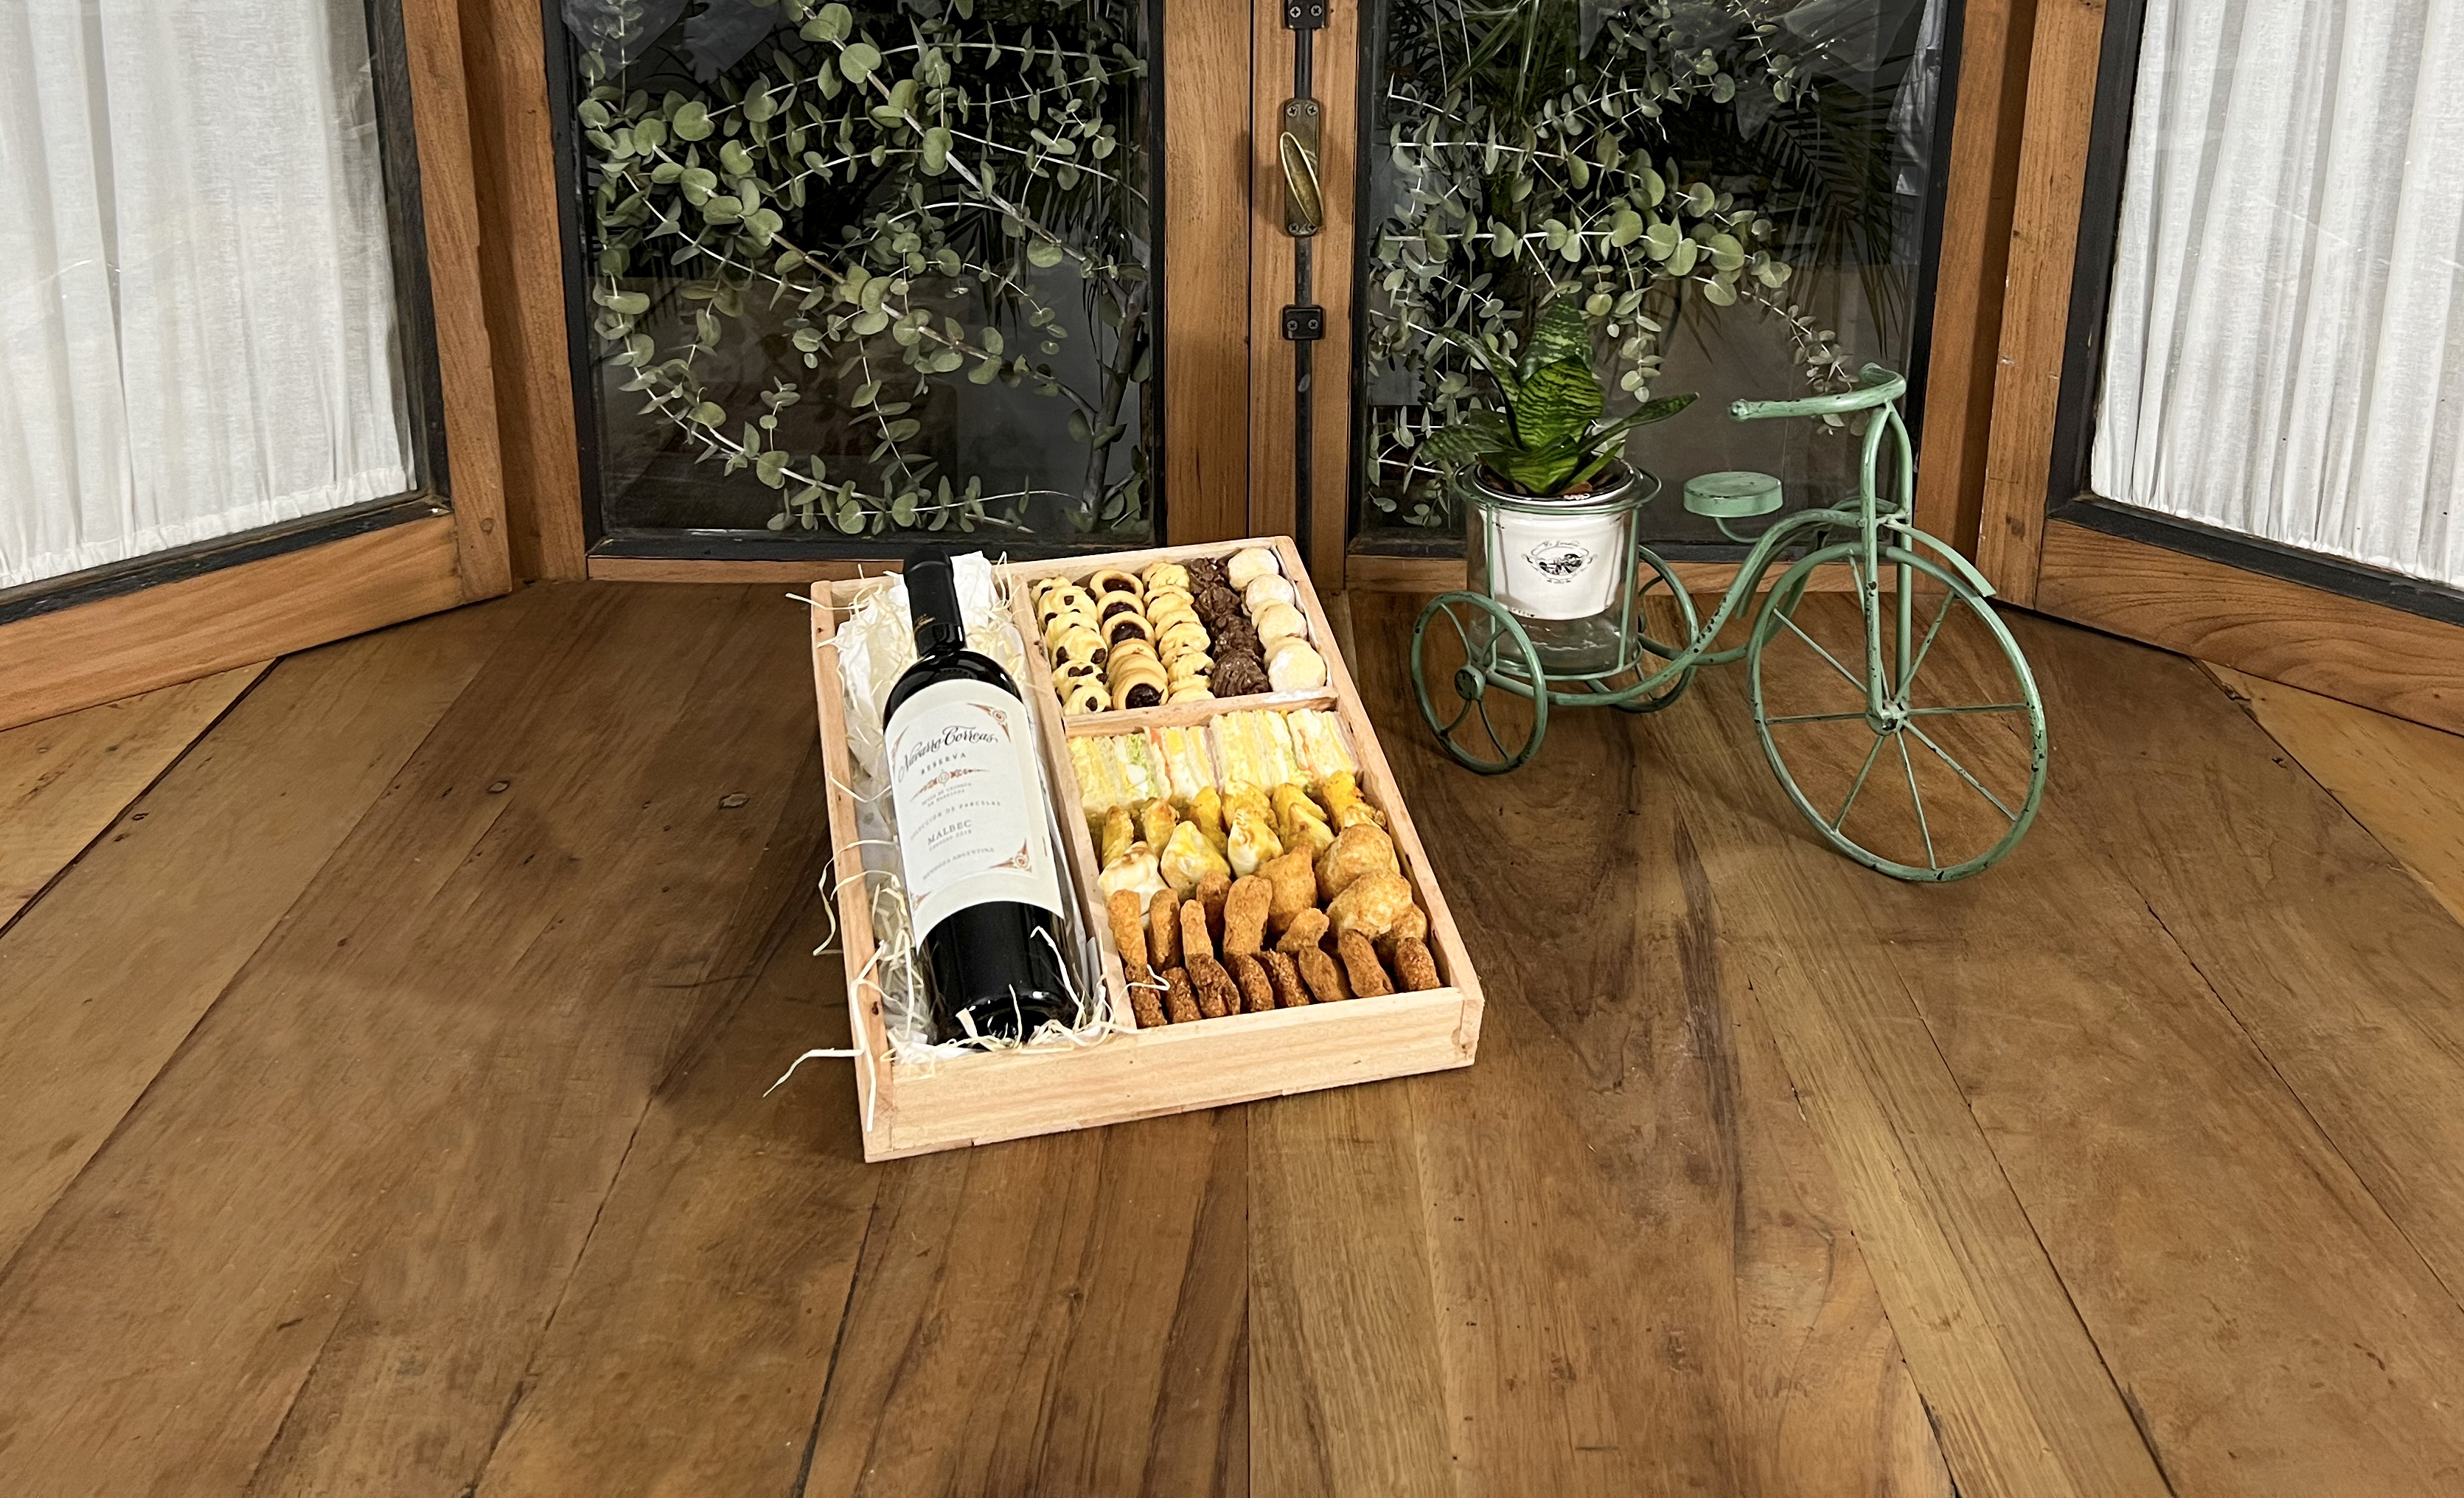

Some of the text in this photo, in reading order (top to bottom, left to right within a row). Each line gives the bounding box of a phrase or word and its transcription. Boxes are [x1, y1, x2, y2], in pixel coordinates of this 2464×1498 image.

[898, 725, 998, 784] Navarro Correas
[921, 752, 967, 776] RESERVA
[945, 807, 955, 815] DE
[959, 800, 1001, 810] PARCELAS
[928, 819, 972, 846] MALBEC
